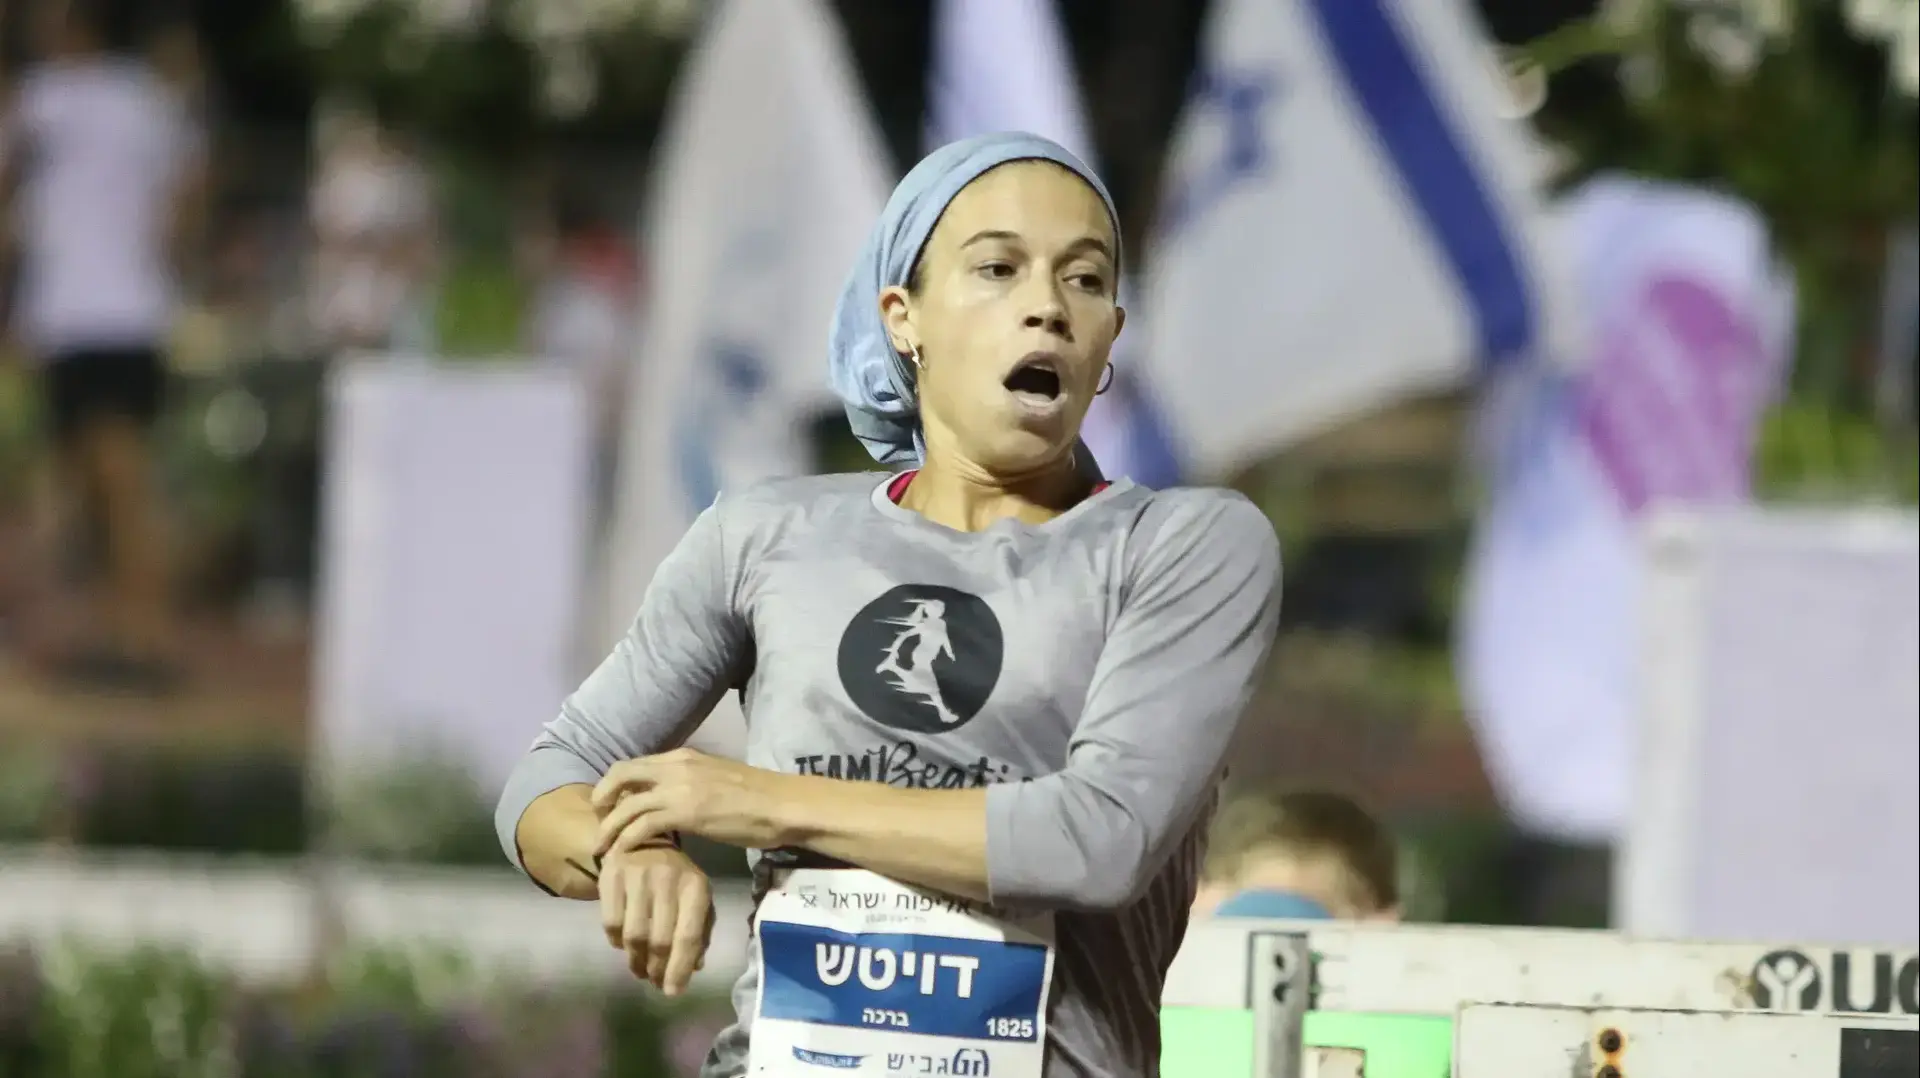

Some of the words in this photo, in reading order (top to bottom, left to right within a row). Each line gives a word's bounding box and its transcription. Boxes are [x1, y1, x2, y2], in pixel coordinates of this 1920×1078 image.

[795, 754, 871, 781] TEAM
[866, 740, 1034, 790] Beati
[828, 888, 887, 909] ישראל
[815, 942, 980, 999] דויטש
[862, 1008, 910, 1027] ברכה
[986, 1018, 1033, 1039] 1825
[887, 1052, 949, 1076] גביש
